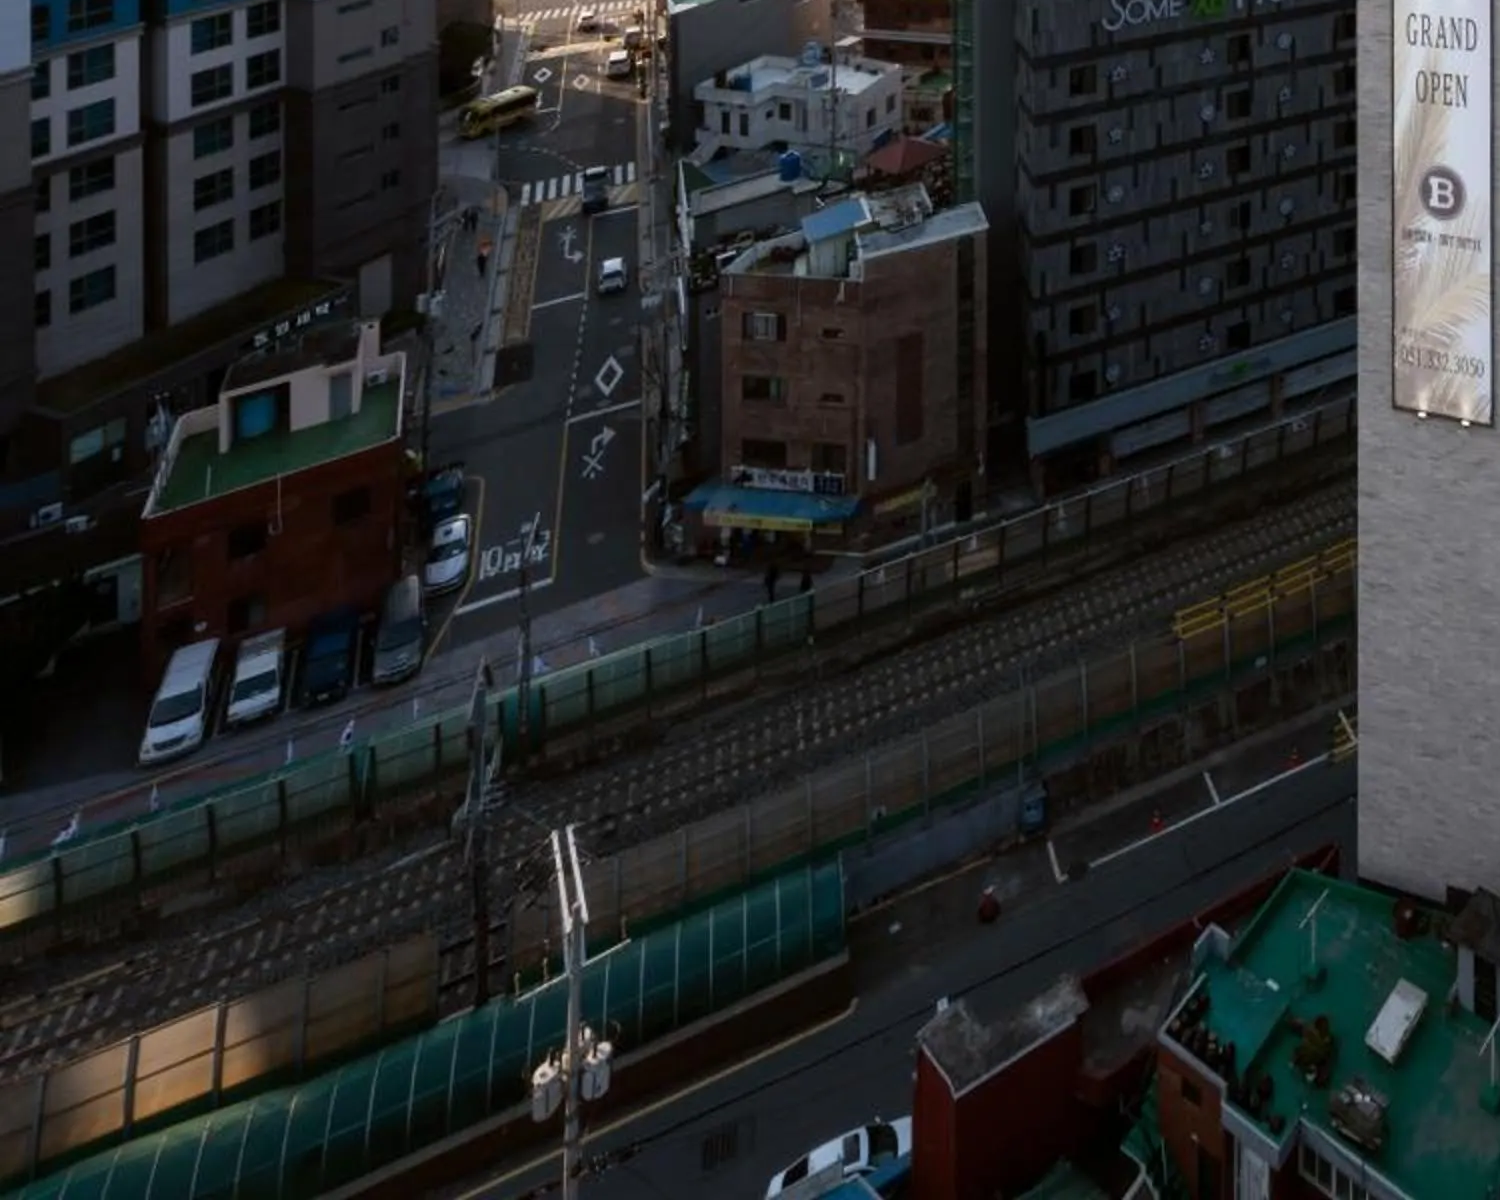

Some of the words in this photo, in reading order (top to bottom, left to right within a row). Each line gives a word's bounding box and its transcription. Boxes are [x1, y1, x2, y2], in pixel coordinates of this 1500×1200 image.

[1406, 12, 1477, 51] GRAND
[1415, 70, 1468, 108] OPEN
[1428, 177, 1455, 210] B
